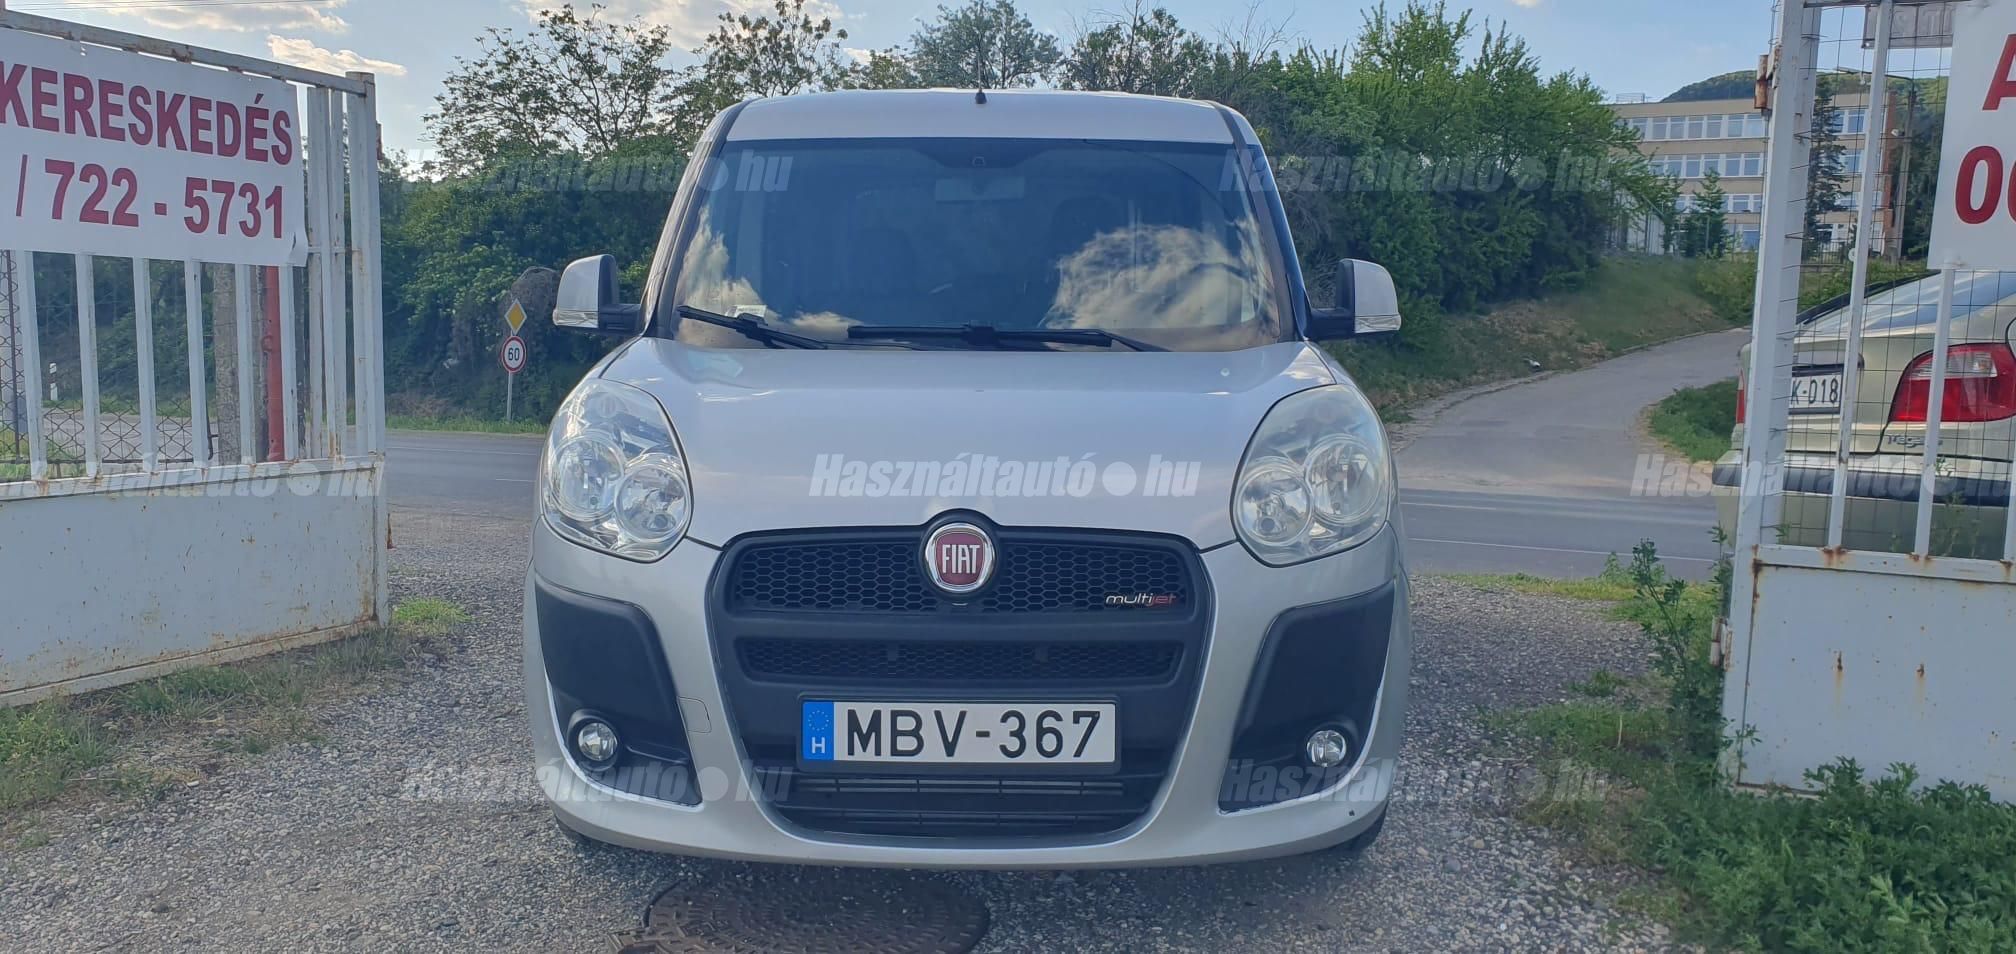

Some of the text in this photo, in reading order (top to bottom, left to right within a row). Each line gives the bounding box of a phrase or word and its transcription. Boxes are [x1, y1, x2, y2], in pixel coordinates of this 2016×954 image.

[0, 61, 292, 165] KERESKEDÉS
[45, 158, 139, 227] 722
[184, 177, 282, 238] 5731
[1955, 145, 2016, 225] 0
[508, 347, 520, 361] 60
[942, 543, 981, 574] FIAT
[1105, 592, 1177, 606] multijet
[811, 709, 1101, 759] H MBV-367
